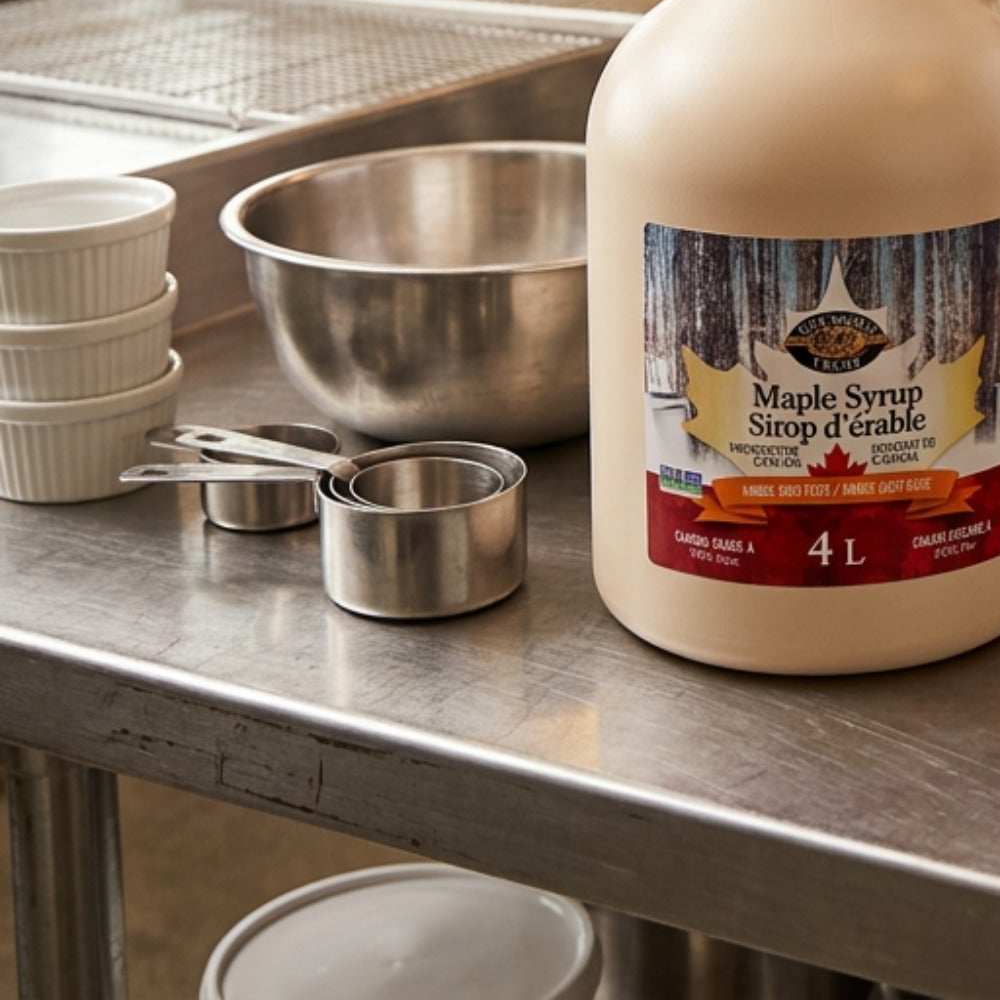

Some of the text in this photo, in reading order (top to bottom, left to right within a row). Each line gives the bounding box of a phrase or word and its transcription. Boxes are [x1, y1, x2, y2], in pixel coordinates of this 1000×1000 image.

[753, 383, 923, 416] Maple Syrup
[749, 409, 926, 446] Sirop d'érable
[808, 531, 866, 566] 4 L
